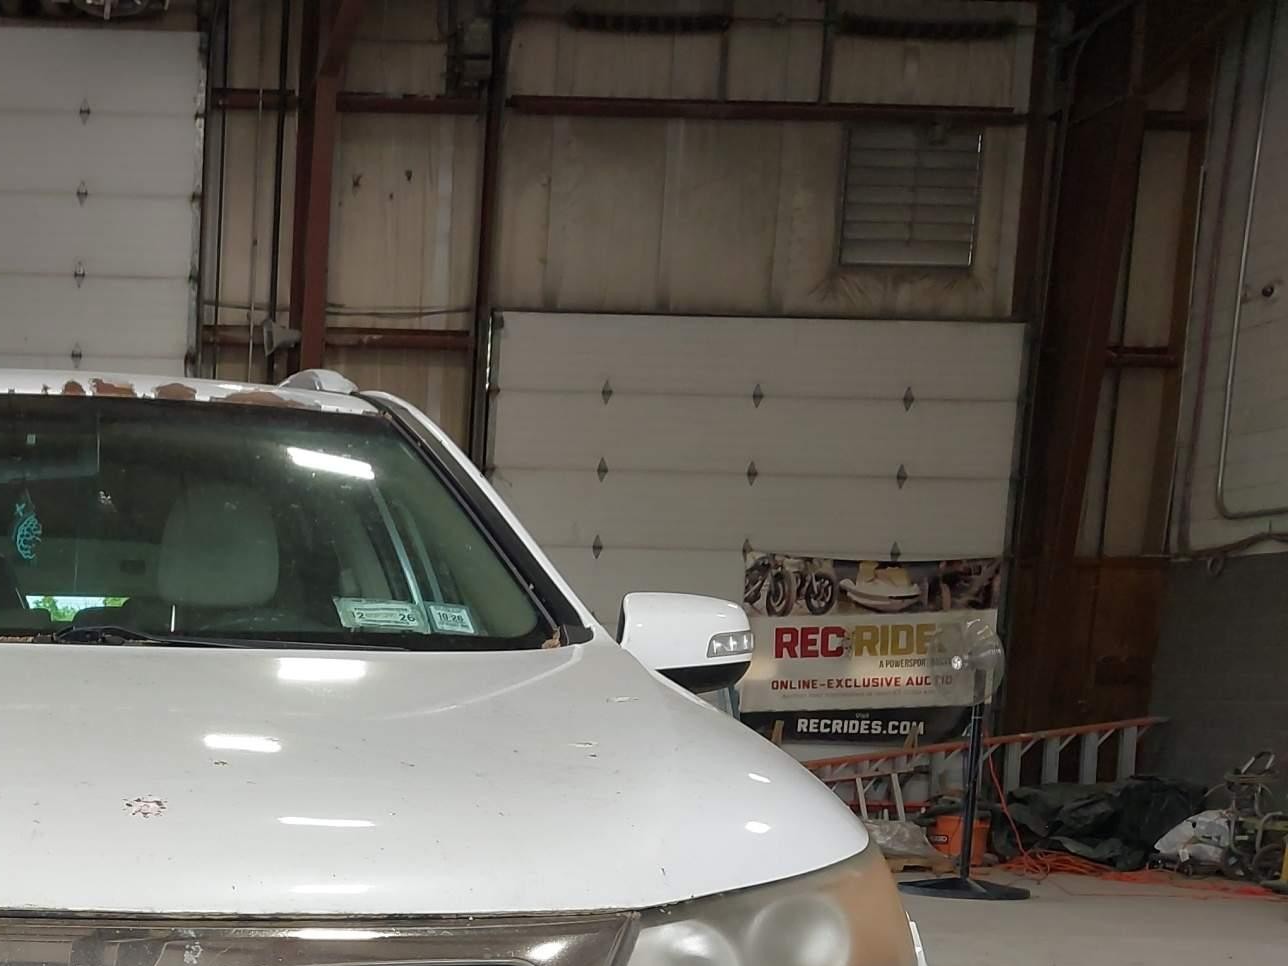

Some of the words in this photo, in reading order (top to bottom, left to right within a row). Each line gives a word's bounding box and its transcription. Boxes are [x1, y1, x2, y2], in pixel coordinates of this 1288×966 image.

[775, 626, 846, 658] REC
[855, 623, 960, 656] RIDE
[885, 658, 929, 669] POWERSPOR
[771, 676, 901, 690] ONLINE-EXCLUSIVE
